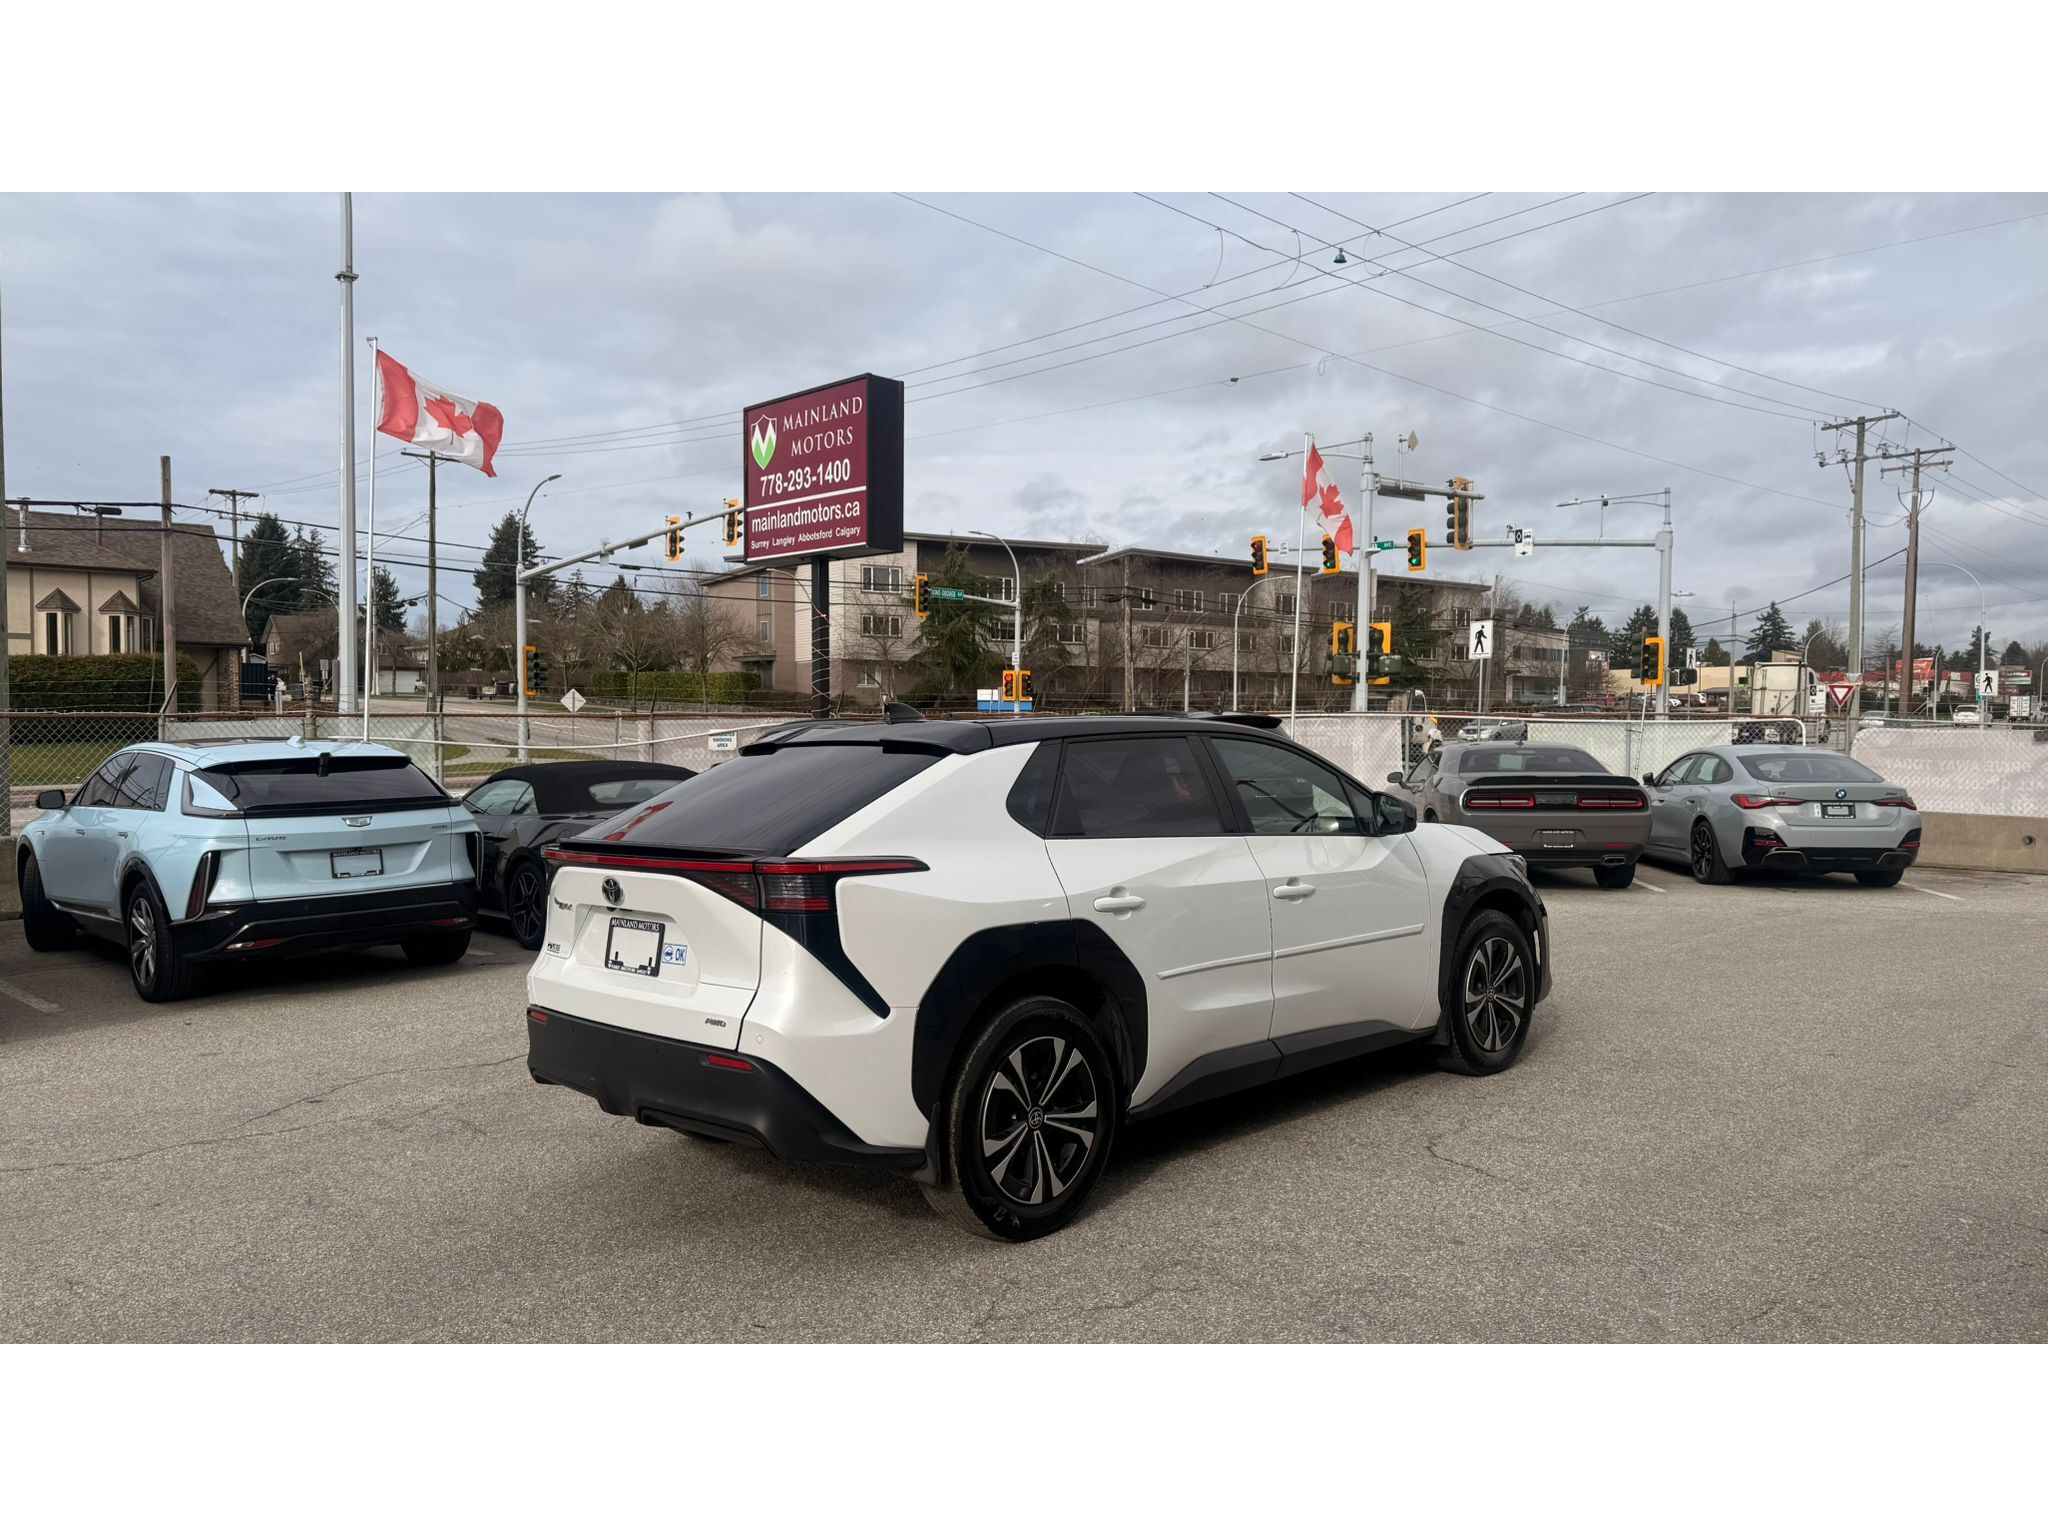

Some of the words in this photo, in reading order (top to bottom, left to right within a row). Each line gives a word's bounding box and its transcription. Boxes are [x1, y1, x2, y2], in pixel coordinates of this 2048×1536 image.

[783, 396, 863, 432] MAINLAND
[791, 426, 853, 456] MOTORS
[760, 459, 850, 496] 778-293-1400
[752, 501, 860, 531] mainlandmotors.ca
[750, 539, 770, 550] Surrey
[772, 536, 795, 547] Langley
[798, 529, 832, 541] Abbotsford
[835, 525, 861, 538] Calgary
[611, 918, 638, 929] MAINLAND
[638, 922, 660, 932] MOTORS
[675, 948, 686, 962] OK
